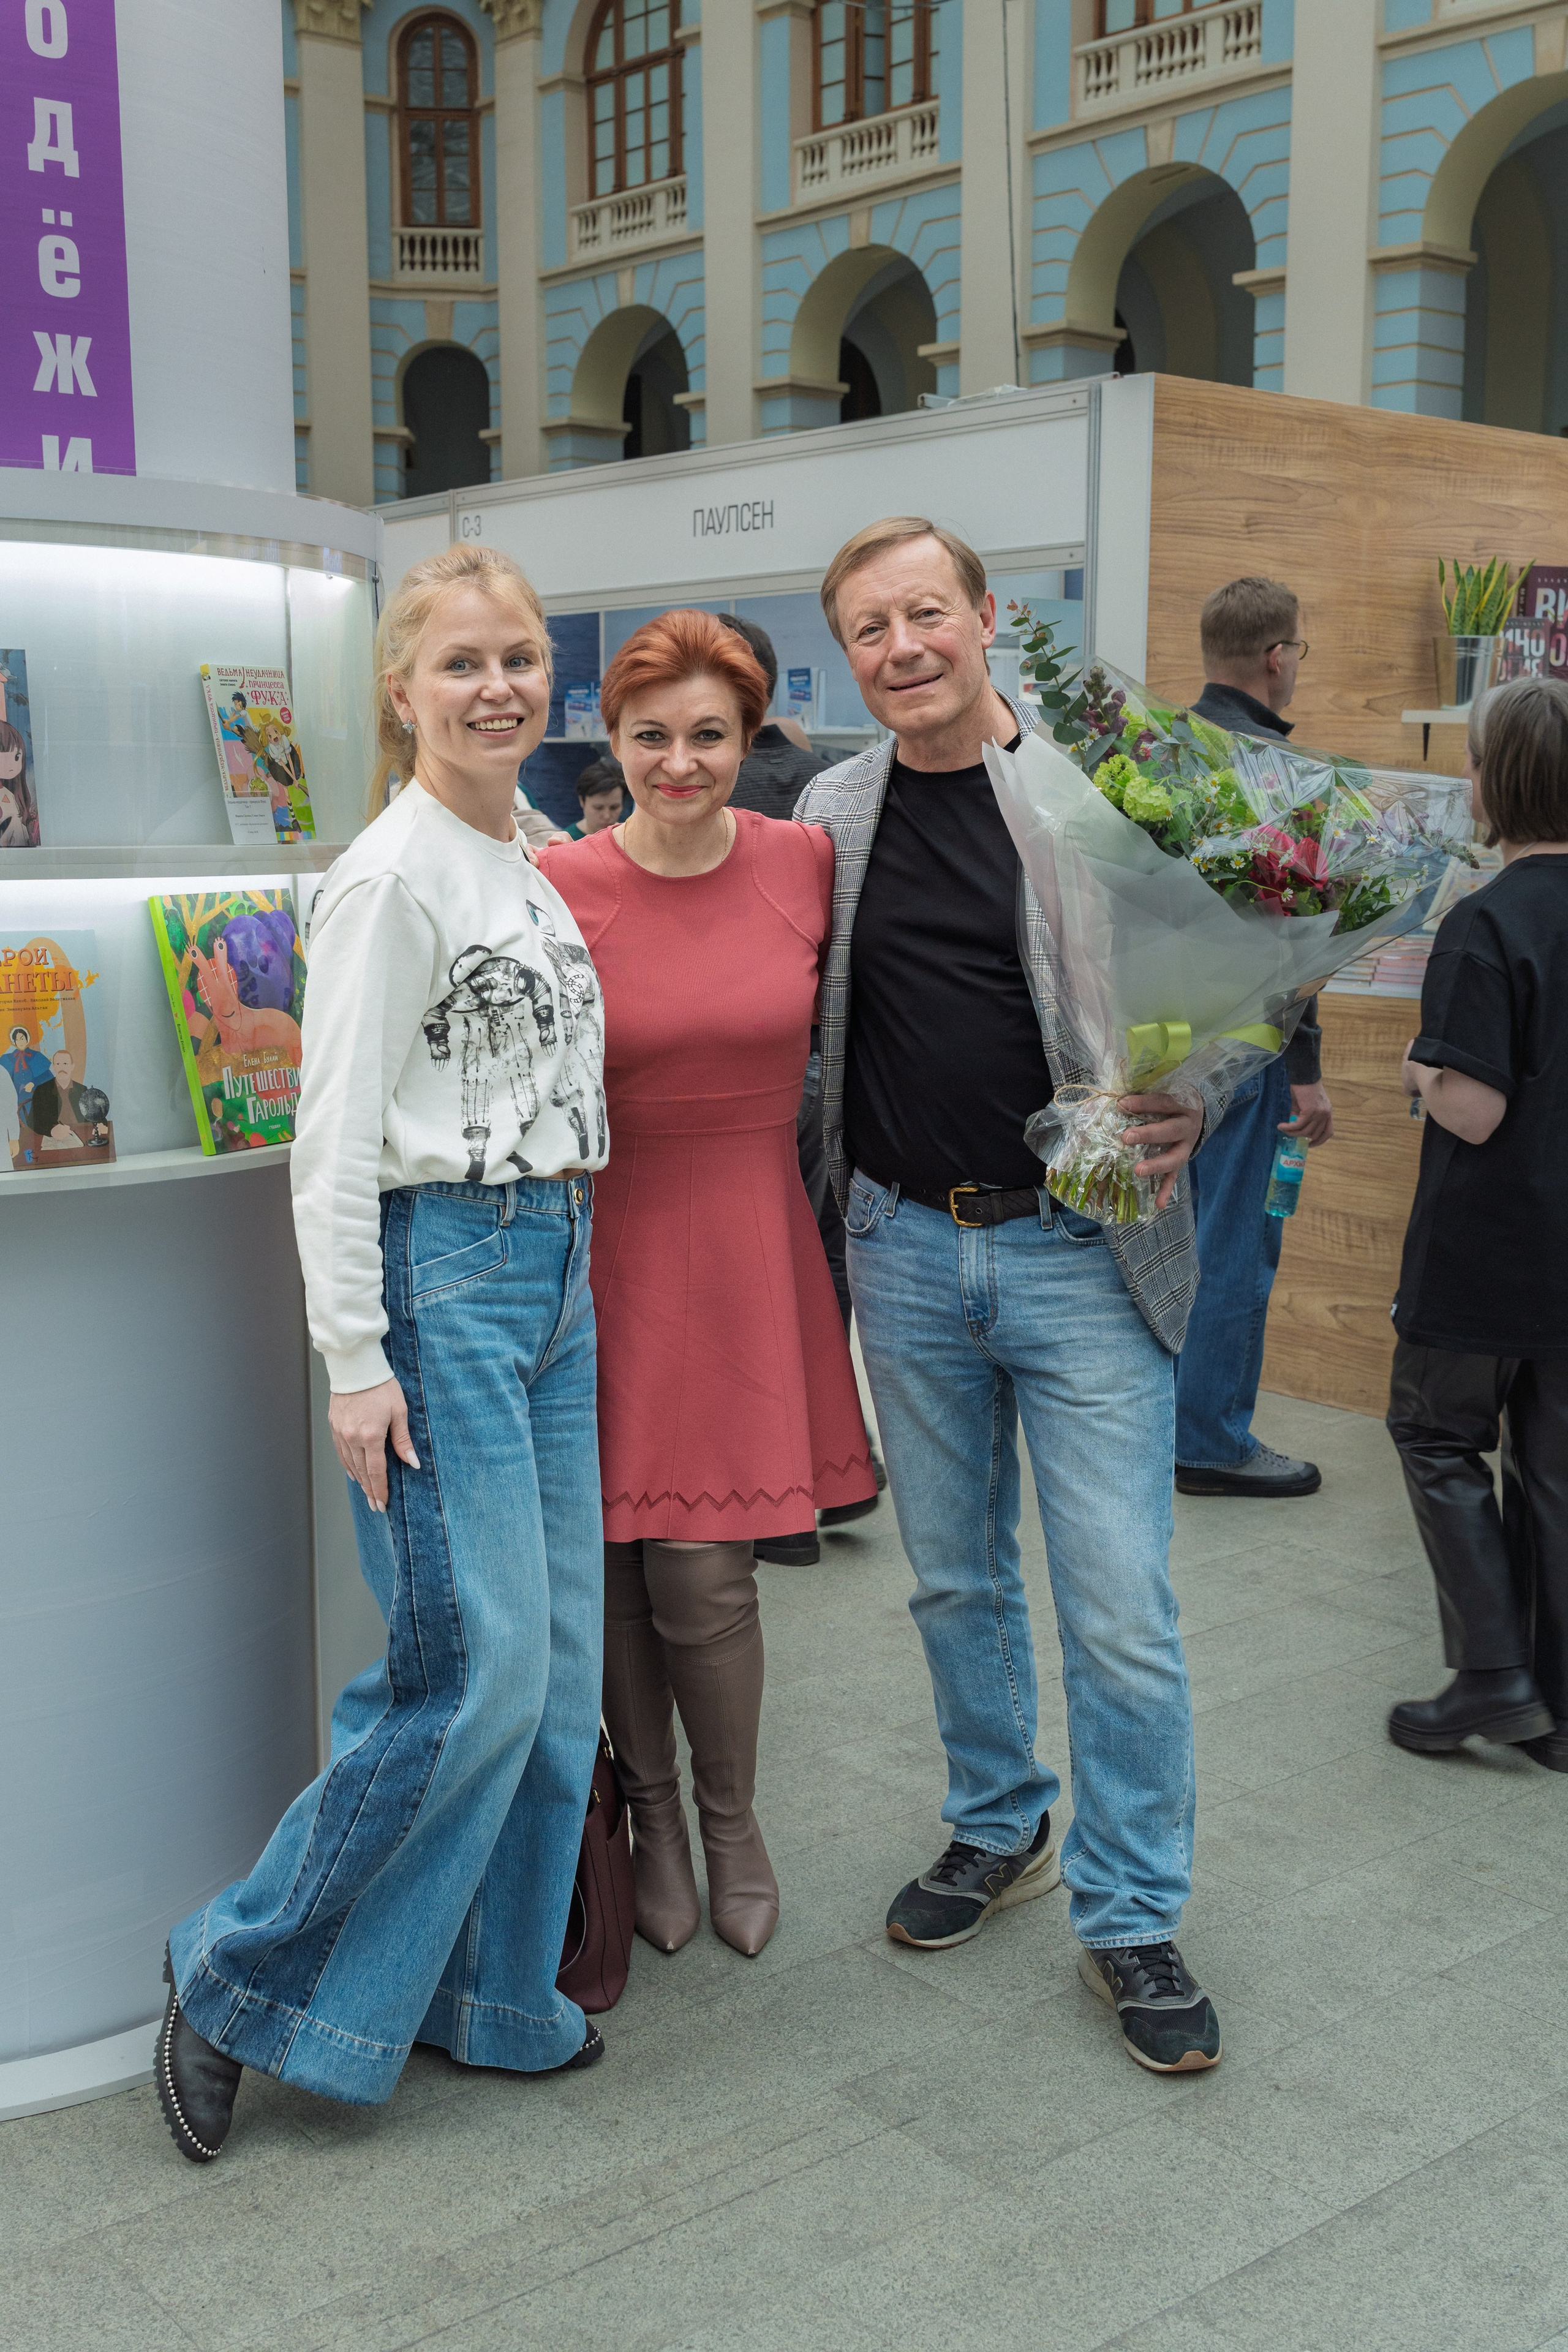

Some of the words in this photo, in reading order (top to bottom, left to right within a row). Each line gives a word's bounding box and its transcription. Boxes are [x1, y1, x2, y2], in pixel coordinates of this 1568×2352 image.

[693, 499, 774, 537] ПАУЛСЕН
[217, 668, 243, 677] ВЕДЬМА
[246, 669, 285, 679] НЕУДАЧНИЦА
[250, 690, 288, 706] ФУКА
[0, 948, 49, 967] РОИ
